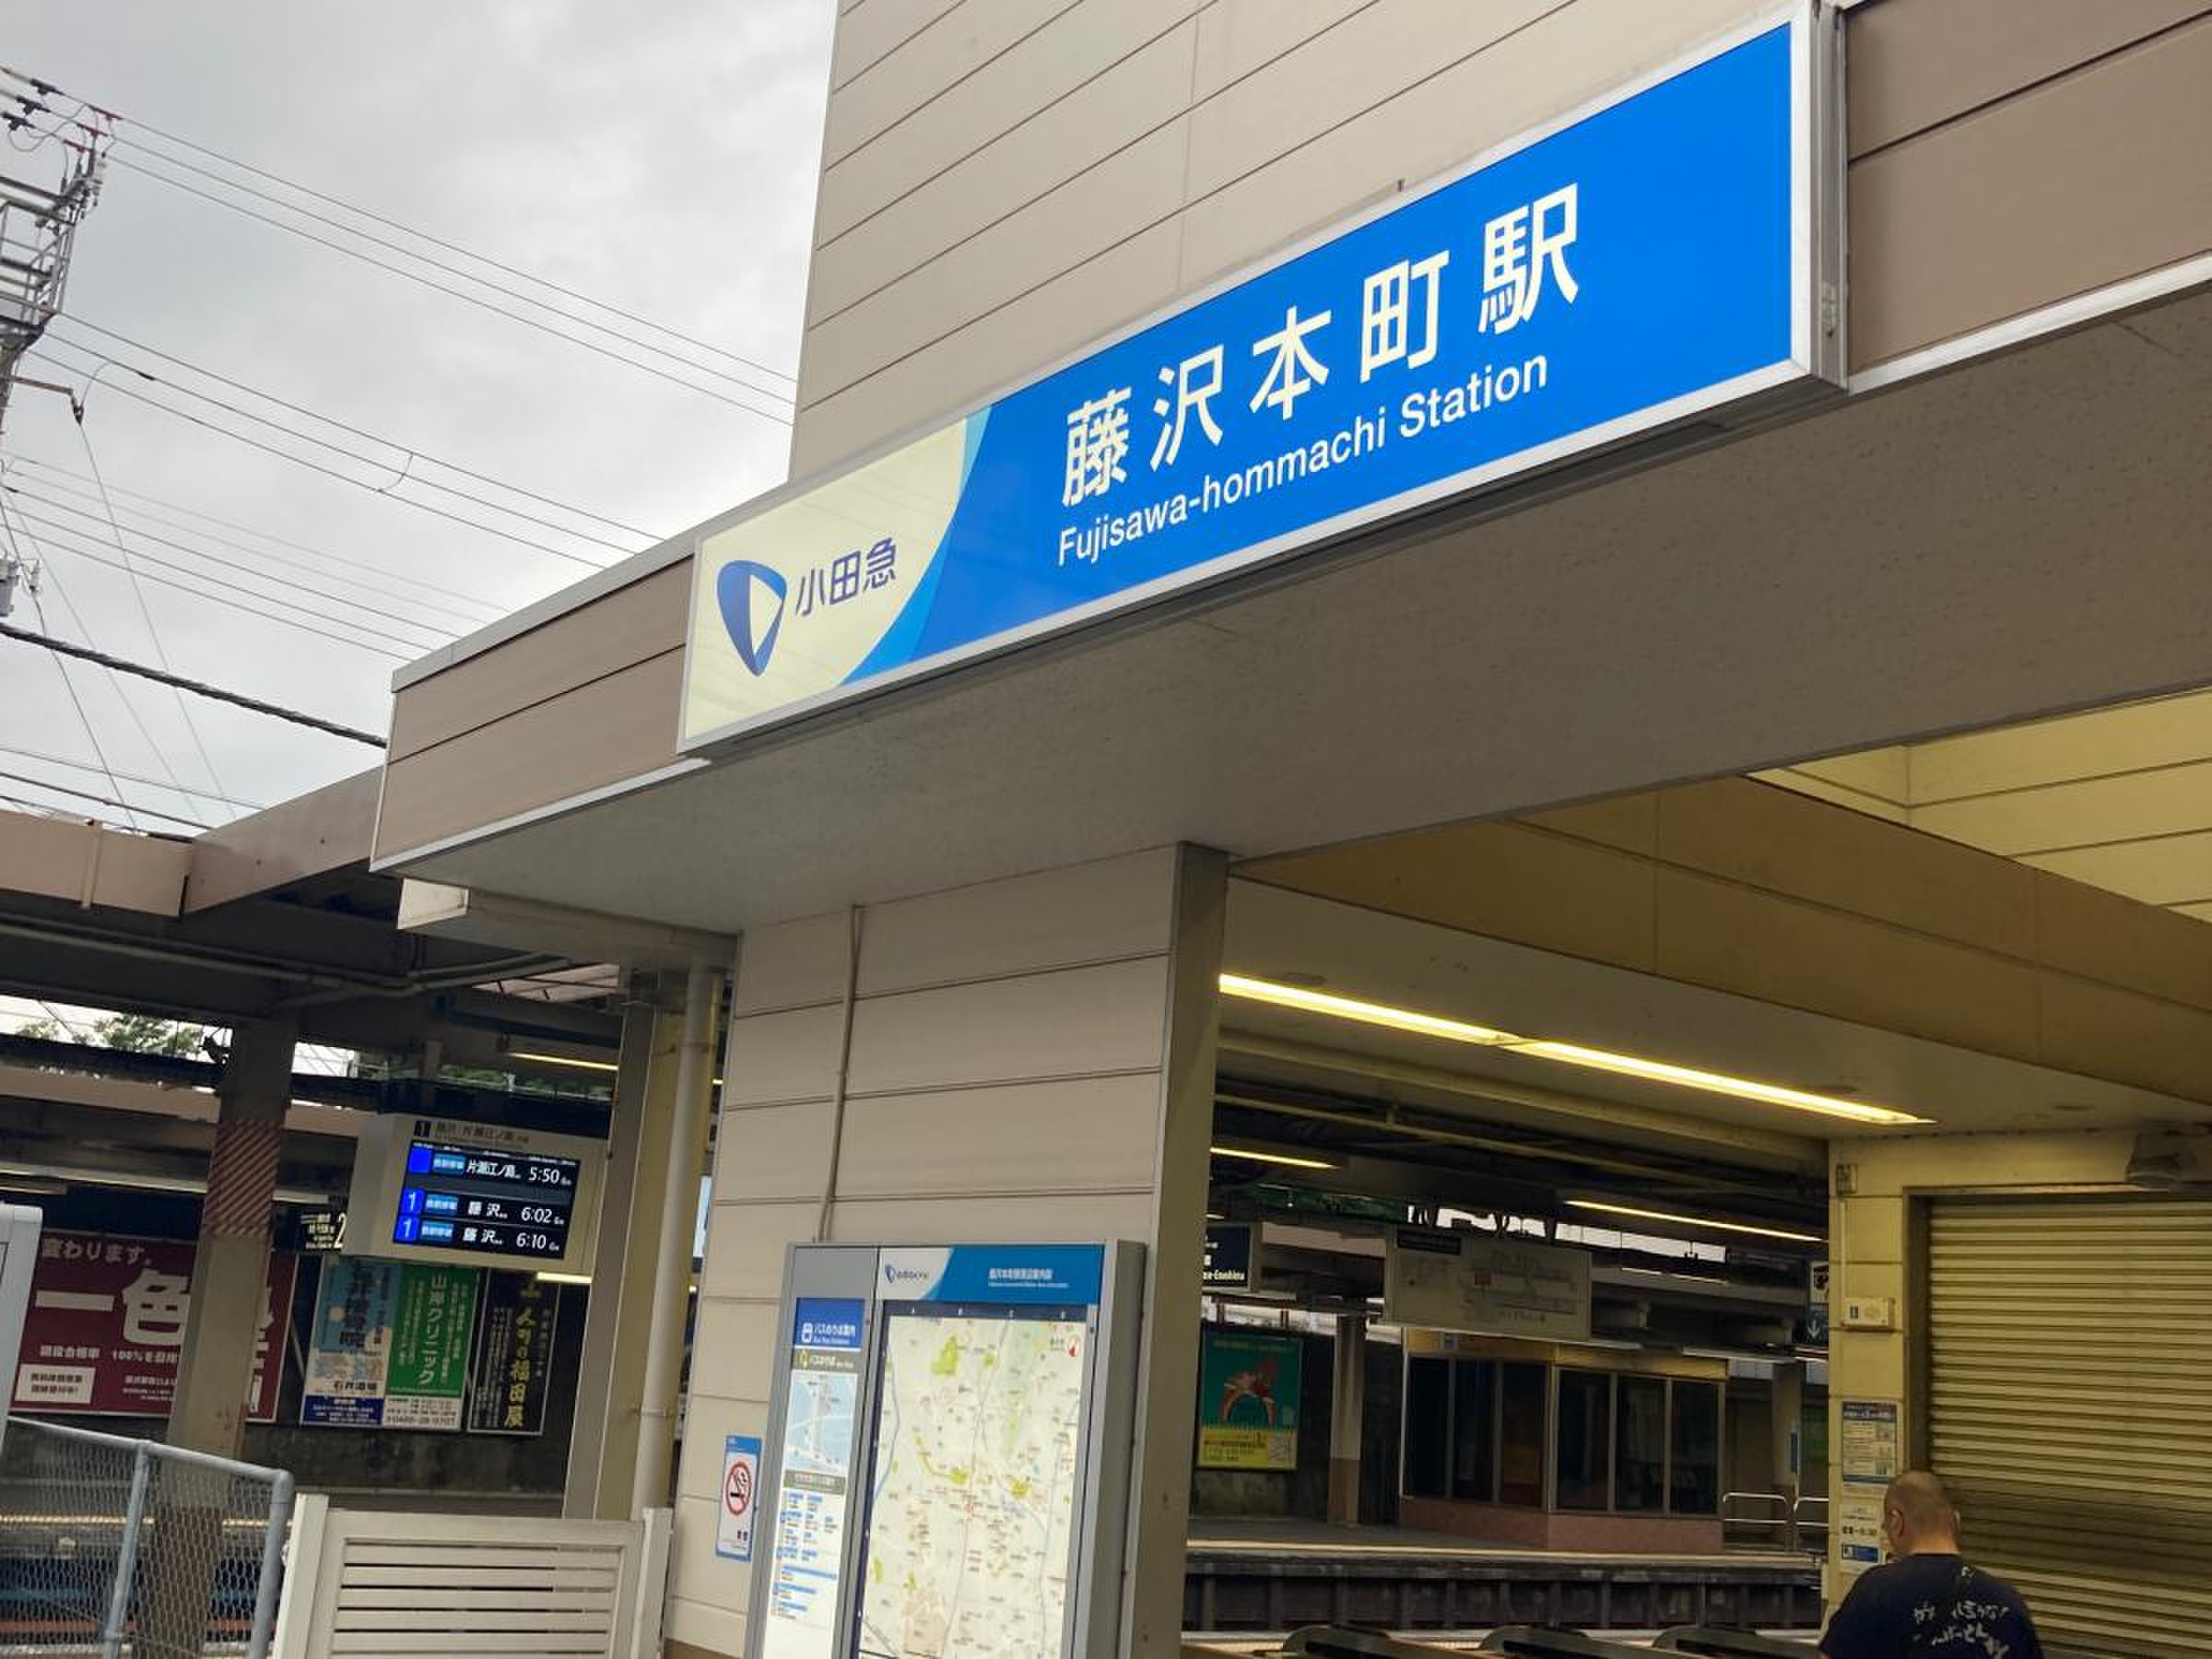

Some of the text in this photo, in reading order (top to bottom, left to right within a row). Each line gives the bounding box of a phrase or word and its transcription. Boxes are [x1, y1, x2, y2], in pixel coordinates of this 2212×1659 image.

[1062, 183, 1579, 508] 藤沢本町駅
[1058, 355, 1547, 566] Fujisawa-hommachi Station
[795, 537, 896, 618] 小田急
[528, 1166, 560, 1183] 5:50
[403, 1218, 412, 1238] 1
[516, 1232, 547, 1250] 6:10
[408, 1192, 417, 1211] 1
[521, 1206, 552, 1224] 6:02
